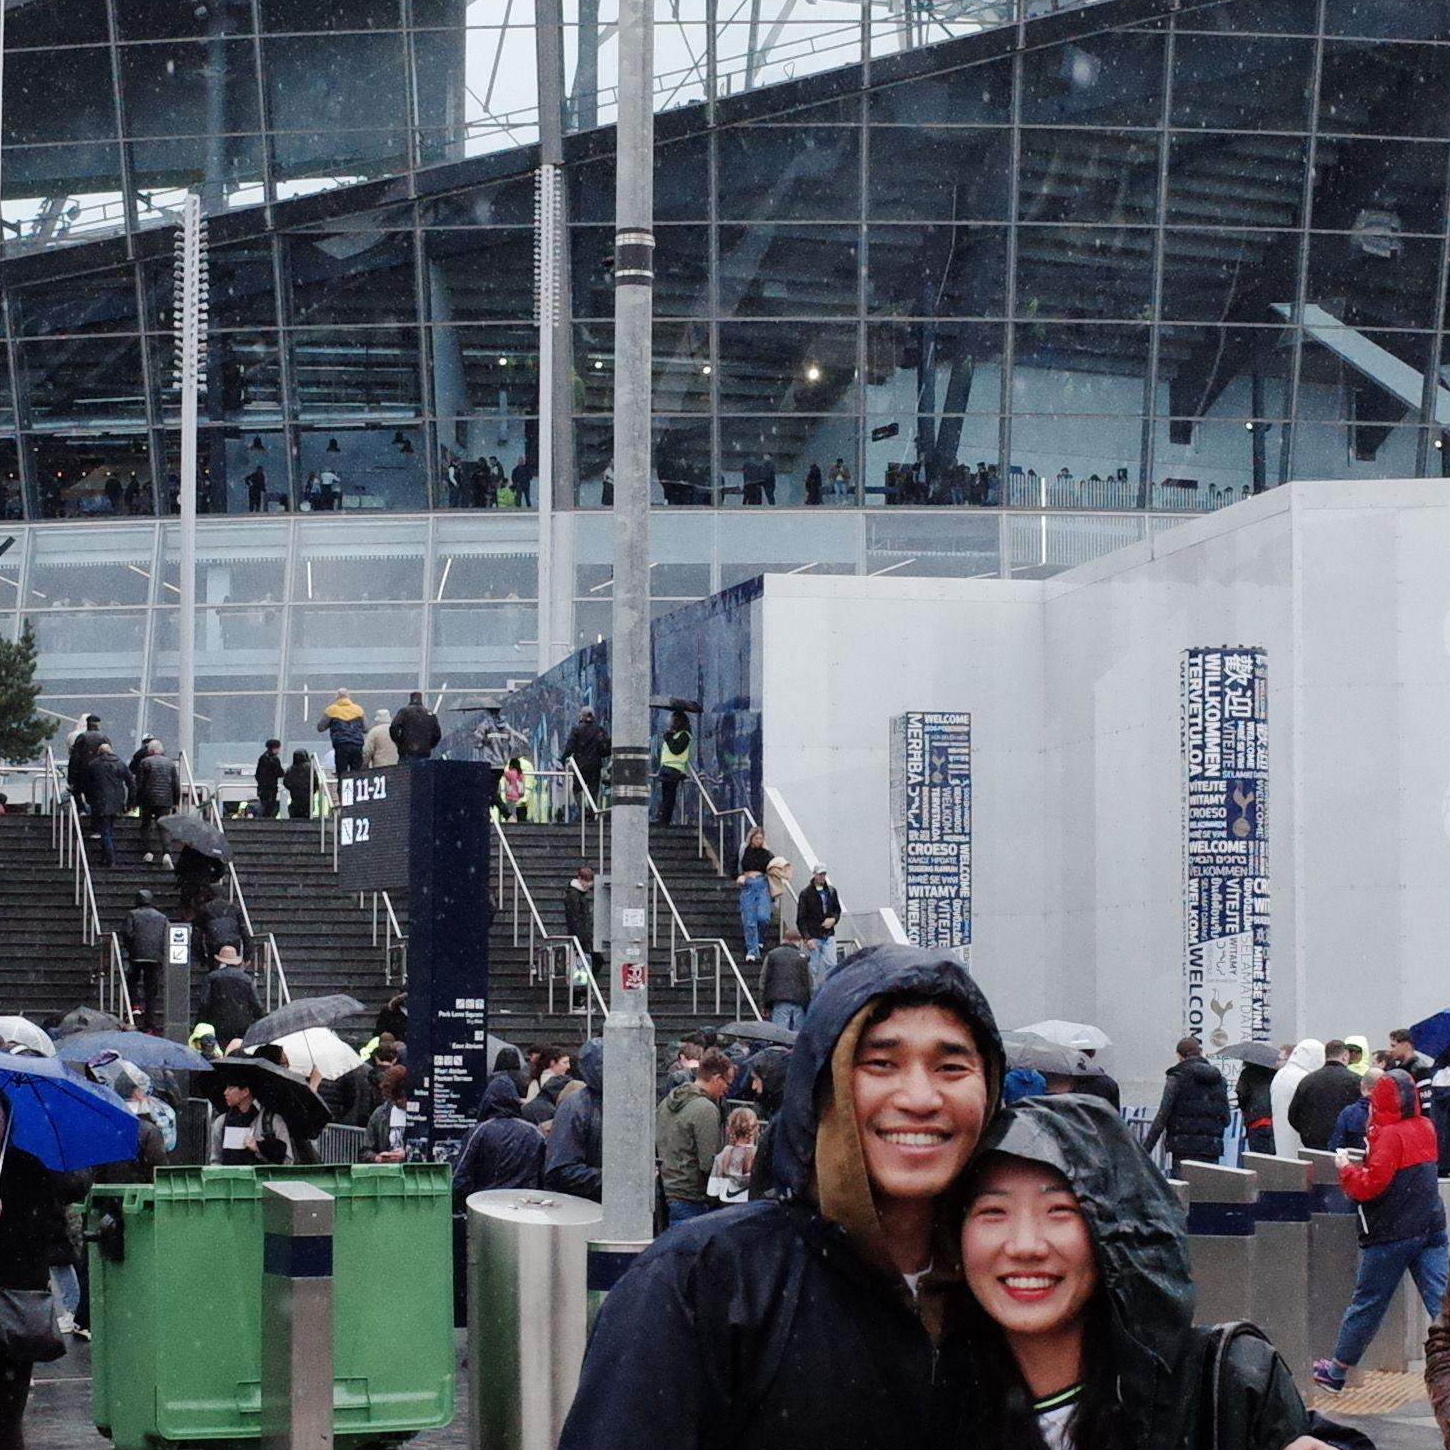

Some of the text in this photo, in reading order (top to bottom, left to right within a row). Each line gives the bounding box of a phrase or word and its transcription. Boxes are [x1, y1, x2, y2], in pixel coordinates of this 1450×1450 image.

[924, 715, 970, 725] WELCOME
[1189, 654, 1203, 776] TERVETULOA
[1204, 652, 1221, 777] WILLKOMMEN
[907, 713, 924, 784] MERHBA
[1246, 721, 1255, 769] WELCOME
[355, 775, 387, 802] 11-21
[942, 787, 953, 836] WELKOM
[1255, 780, 1264, 839] WELCOME
[355, 818, 370, 842] 22
[931, 787, 941, 842] TERVETULOA
[908, 843, 958, 856] CROESO
[1189, 841, 1247, 853] WELCOME
[908, 886, 958, 898] WITAMY
[959, 845, 970, 898] WELCOME
[908, 900, 920, 948] WELKO
[1189, 877, 1199, 943] WELKOM
[1225, 877, 1241, 934] VÍTEJTE
[1228, 937, 1238, 975] WITAMY
[1189, 948, 1204, 1054] WELCOM
[1253, 981, 1263, 1001] SE
[1240, 1005, 1252, 1042] DATA
[1253, 1003, 1263, 1028] VINI
